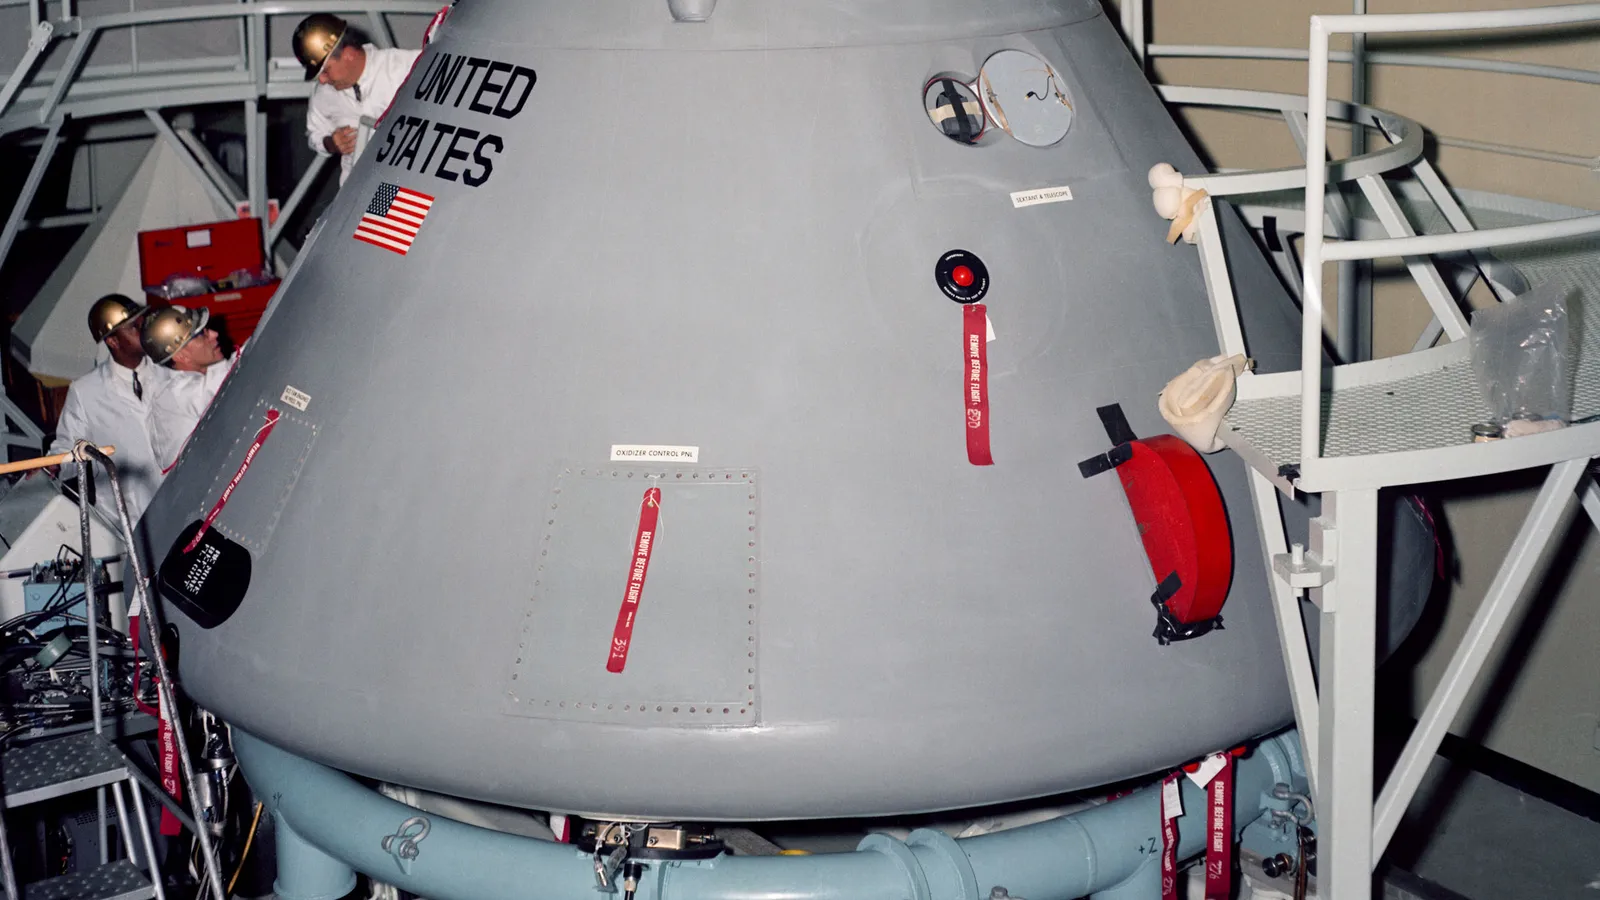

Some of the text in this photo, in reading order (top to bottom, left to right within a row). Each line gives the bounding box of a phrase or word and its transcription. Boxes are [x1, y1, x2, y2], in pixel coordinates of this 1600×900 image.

[414, 52, 537, 119] UNITED
[375, 115, 503, 187] STATES
[1016, 195, 1038, 203] SEXTANT
[970, 334, 981, 403] REMOVE BEFORE FLIGHT
[222, 442, 260, 502] REMOVE BEFORE FLIGHT
[638, 531, 652, 557] REMOVE
[632, 557, 645, 581] BEFORE
[627, 582, 641, 604] FLIGHT
[612, 637, 627, 659] 391
[163, 732, 173, 753] BEFORE
[165, 754, 173, 773] FLIGHT
[1213, 781, 1224, 852] REMOVE BEFORE FLIGHT
